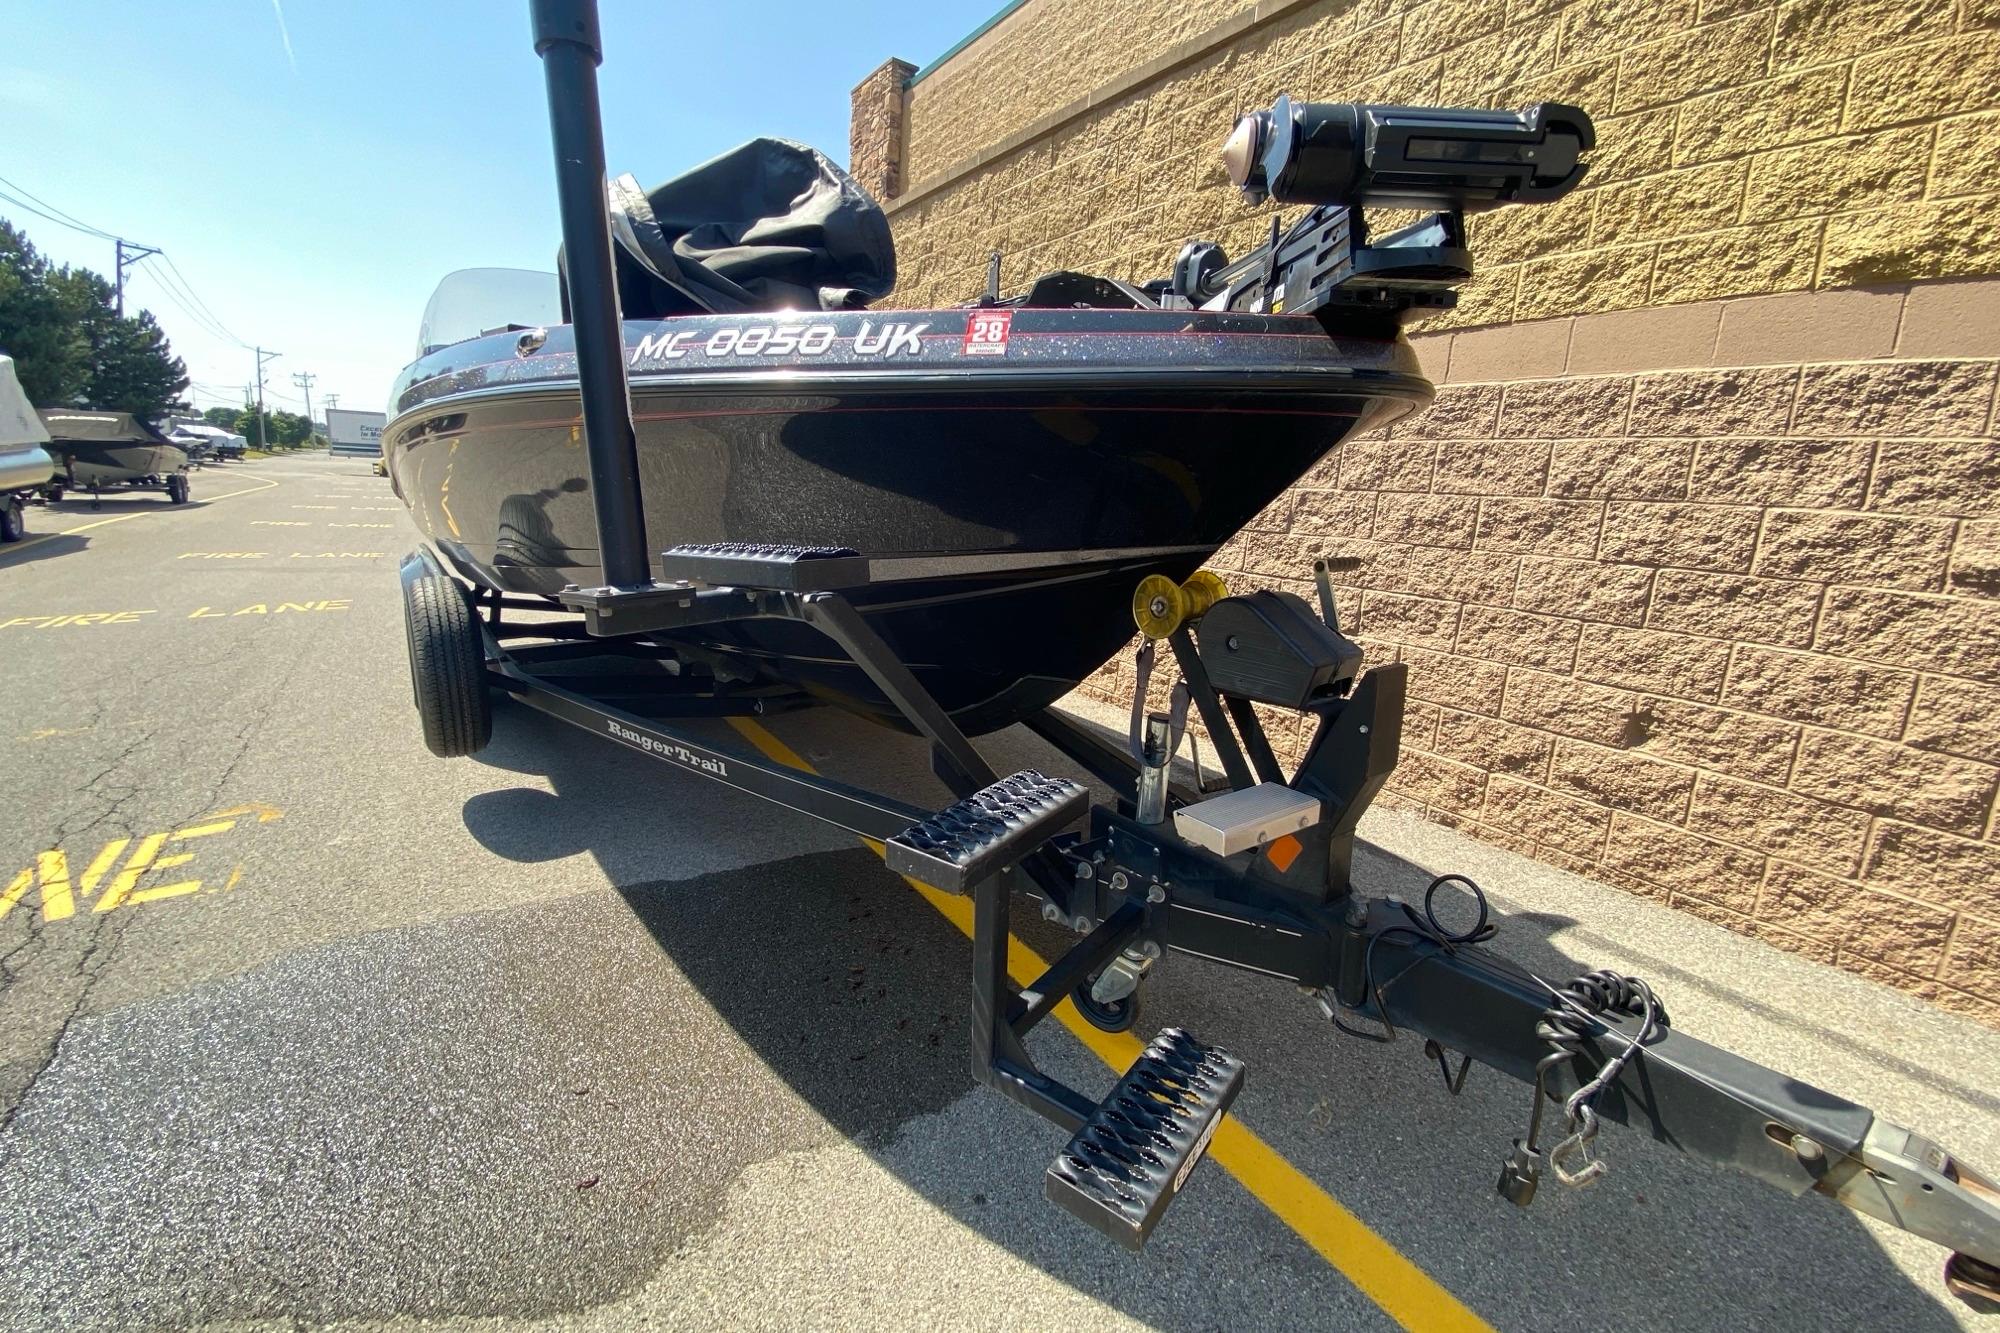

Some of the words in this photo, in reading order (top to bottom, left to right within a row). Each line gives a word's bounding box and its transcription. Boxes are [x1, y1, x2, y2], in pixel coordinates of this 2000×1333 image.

[631, 332, 698, 365] MC
[853, 320, 931, 358] UK
[972, 321, 1004, 343] 28
[177, 552, 268, 560] FIRE
[0, 610, 157, 629] FIRE
[188, 599, 354, 619] LANE
